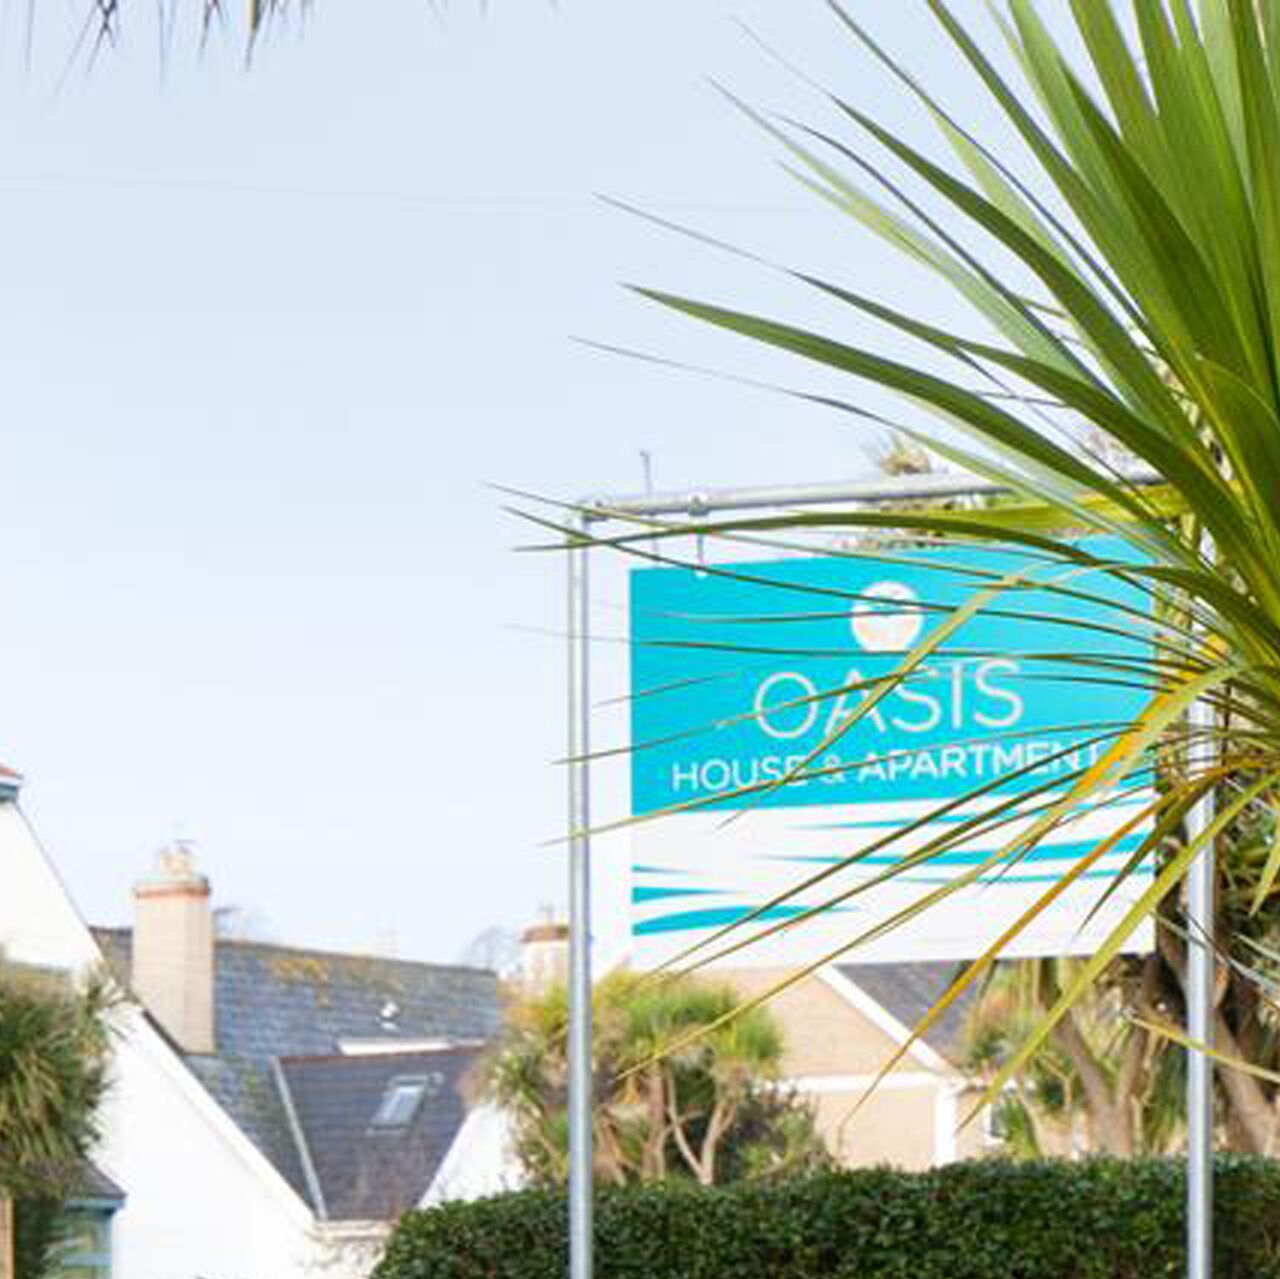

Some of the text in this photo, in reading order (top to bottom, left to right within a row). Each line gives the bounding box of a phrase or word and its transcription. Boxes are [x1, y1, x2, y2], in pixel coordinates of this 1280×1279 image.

[753, 658, 1025, 739] OASIS
[672, 738, 1110, 791] HOUSE & APARTMENT
